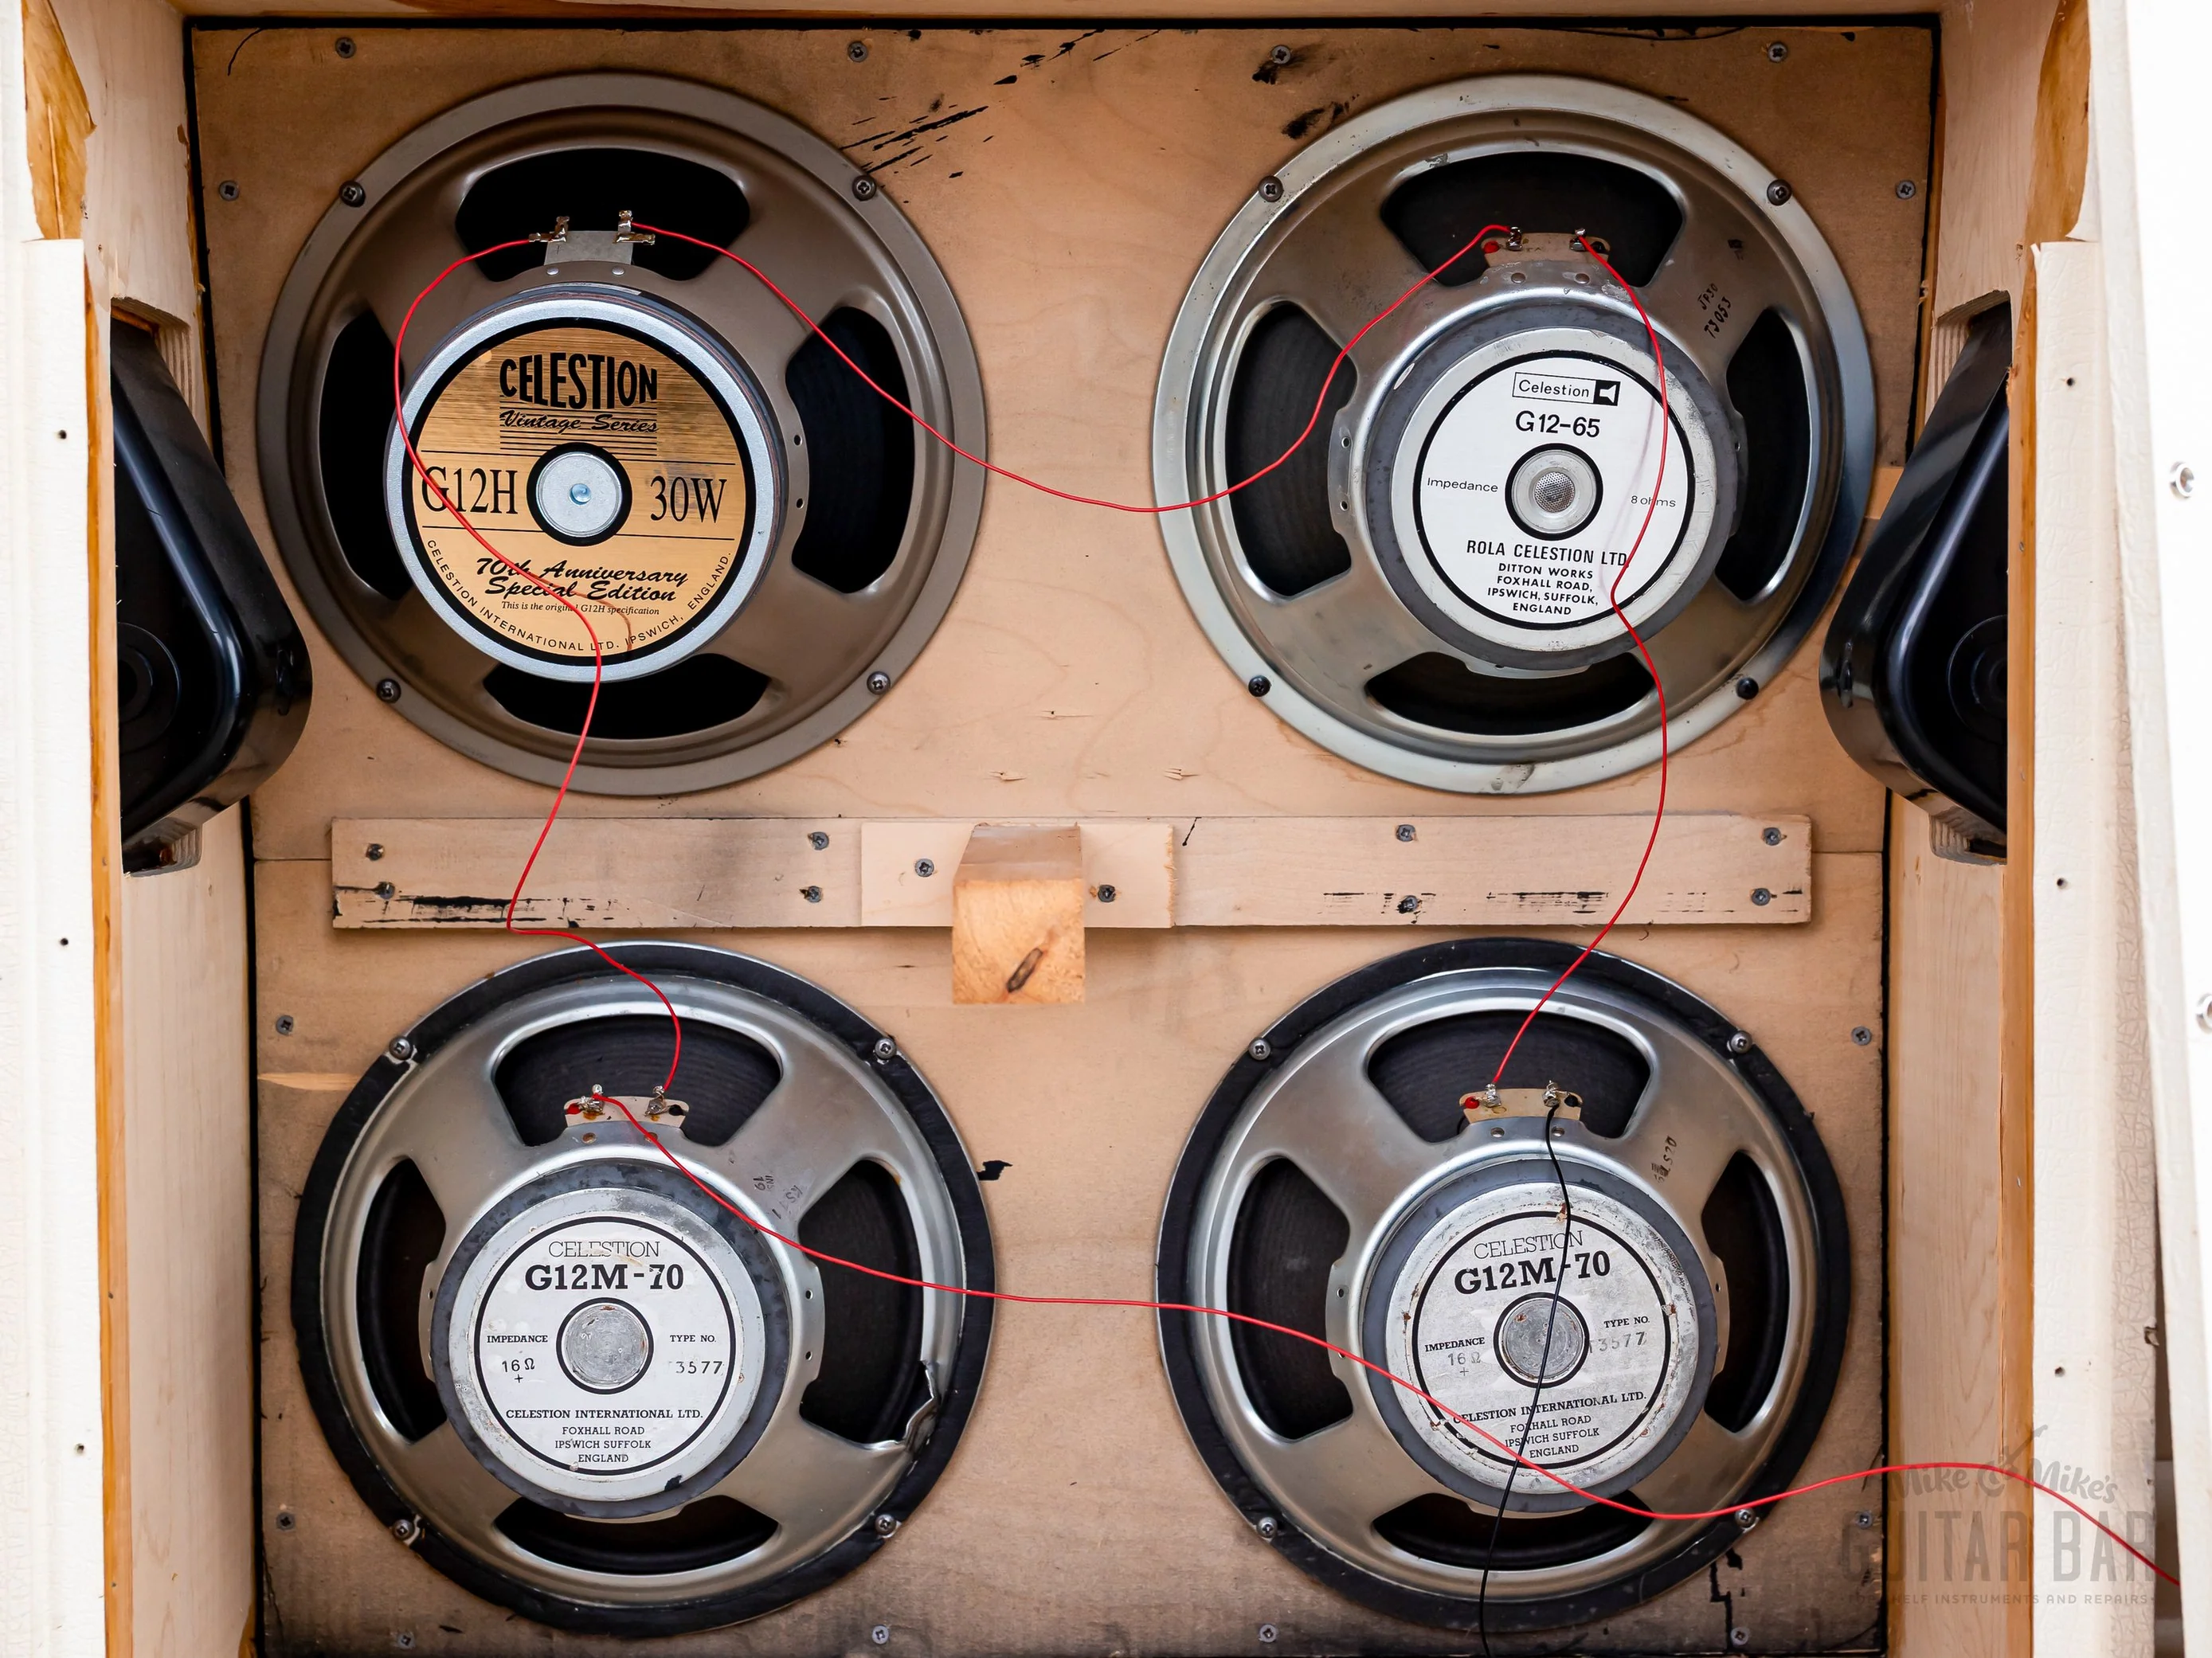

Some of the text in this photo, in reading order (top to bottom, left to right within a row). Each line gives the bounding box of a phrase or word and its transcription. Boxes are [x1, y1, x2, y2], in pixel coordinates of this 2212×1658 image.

[499, 352, 658, 409] CELESTION
[1518, 378, 1590, 398] Celestion
[499, 409, 660, 435] Vintage Series
[1515, 410, 1601, 438] G12-65
[1427, 477, 1498, 493] Impedance
[421, 466, 727, 523] G12H 30W
[1631, 495, 1676, 507] 8 ohms
[1466, 540, 1505, 557] ROLA
[1513, 544, 1594, 564] CELESTION
[476, 557, 689, 588] 70th Anniversary
[1498, 562, 1593, 579] DITTON WORKS
[484, 576, 677, 601] Special Edition
[1497, 575, 1593, 592] FOXHALL ROAD,
[427, 540, 731, 651] CELESTION INTERNATIONAL LTD. IPSWICH, ENGLAND.
[1488, 588, 1599, 606] IPSWICH, SUFFOLK,
[501, 601, 519, 610] This
[530, 602, 543, 611] the
[546, 603, 579, 613] originl
[581, 604, 605, 613] G12H
[607, 604, 660, 616] specification
[1513, 603, 1572, 616] ENGLAND
[548, 1241, 660, 1258] CELESTION
[1474, 1230, 1584, 1260] CELESTION
[525, 1264, 684, 1291] G12M-70
[1454, 1250, 1611, 1295] G12M-70
[1603, 1316, 1650, 1328] TYPE NO.
[487, 1335, 548, 1343] IMPEDANCE
[669, 1334, 717, 1343] TYPE NO.
[1424, 1337, 1486, 1352] IMPEDANCE
[506, 1410, 703, 1419] CELESTION INTERNATIONAL LTD.
[1453, 1391, 1647, 1424] CELESTION INTERNATIONAL LTD.
[1561, 1415, 1592, 1426] ROAD
[562, 1426, 645, 1436] FOXHALL ROAD
[1552, 1428, 1600, 1441] SUFFOLK
[554, 1440, 652, 1449] IPSWICH SUFFOLK
[1529, 1445, 1580, 1459] ENGLAND
[577, 1453, 629, 1464] ENGLAND
